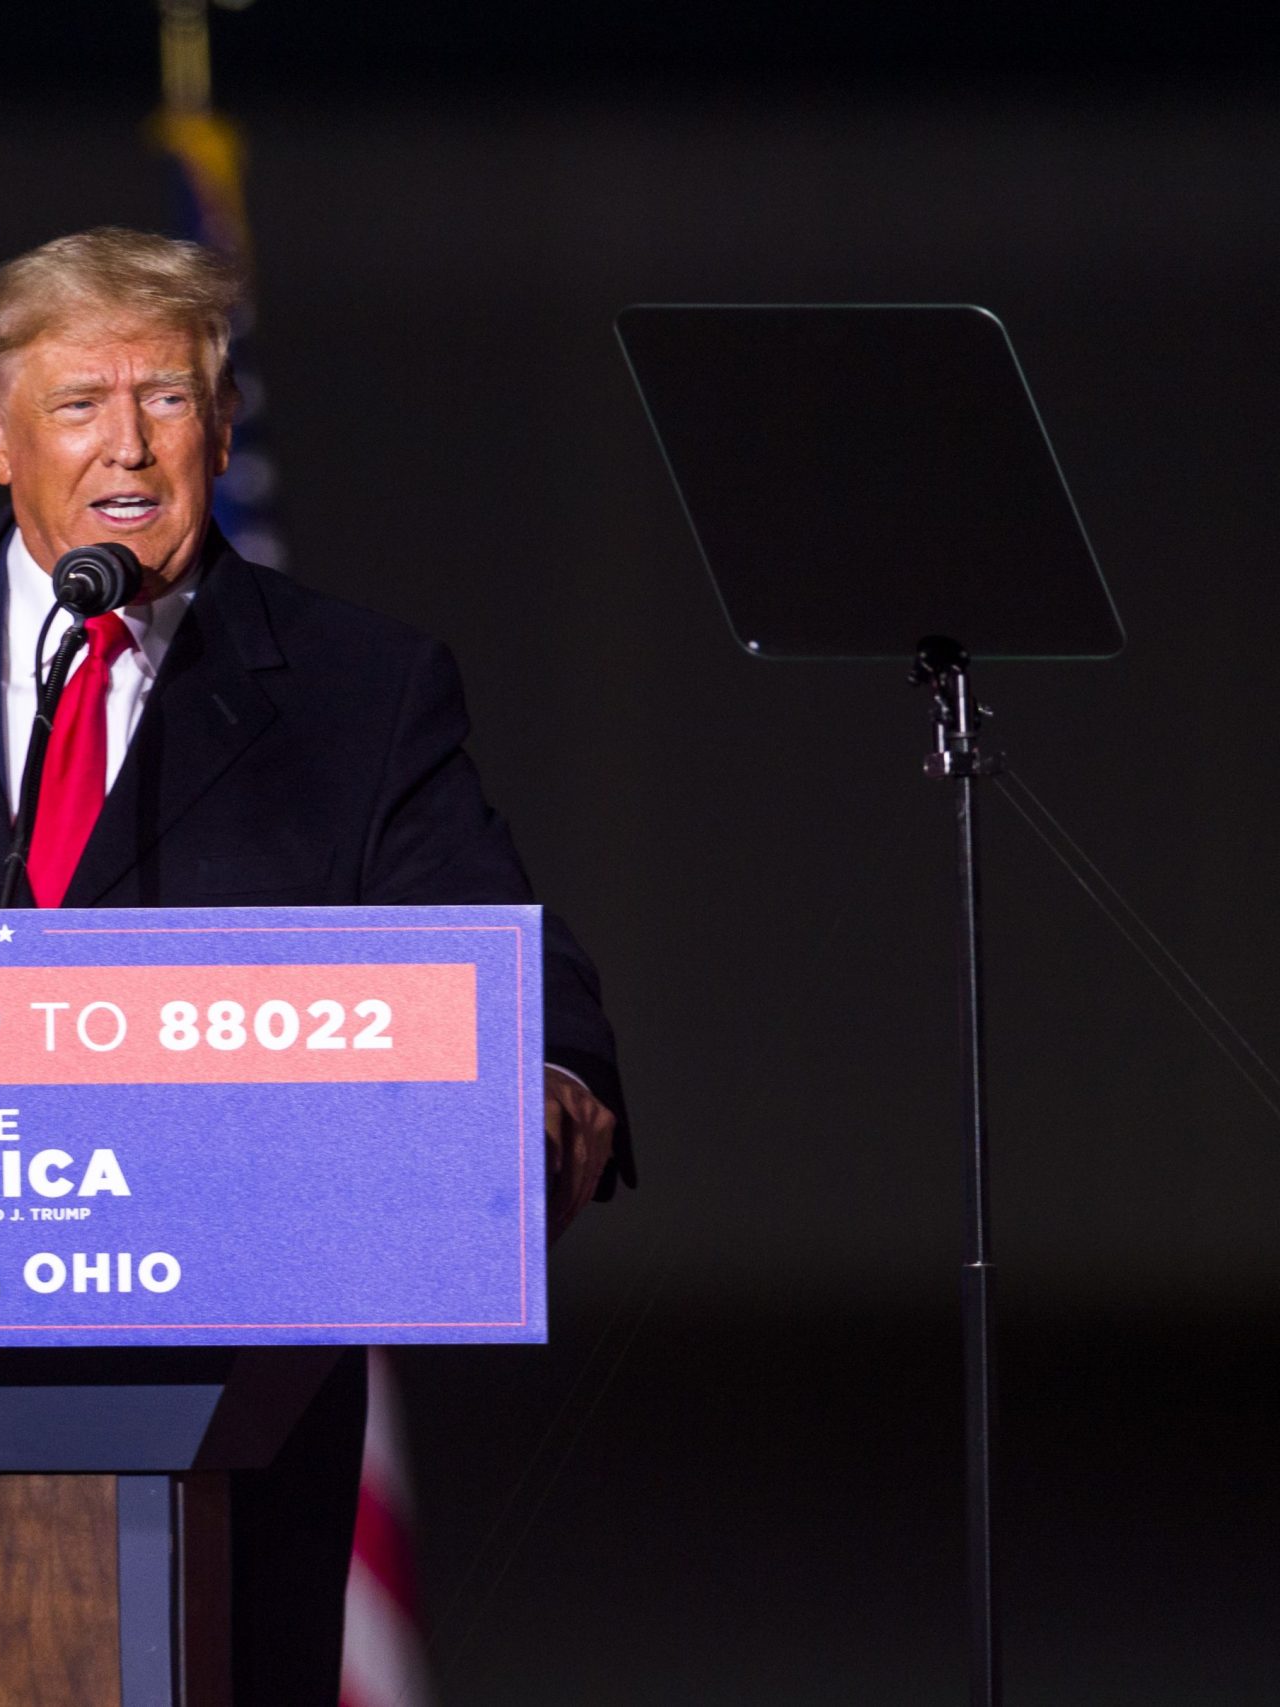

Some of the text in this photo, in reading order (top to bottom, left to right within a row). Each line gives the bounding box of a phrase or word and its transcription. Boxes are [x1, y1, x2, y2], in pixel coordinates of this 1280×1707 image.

[31, 1002, 127, 1051] TO
[159, 999, 392, 1050] 88022
[10, 1209, 24, 1221] J.
[31, 1208, 90, 1220] TRUMP
[24, 1252, 181, 1293] OHIO
